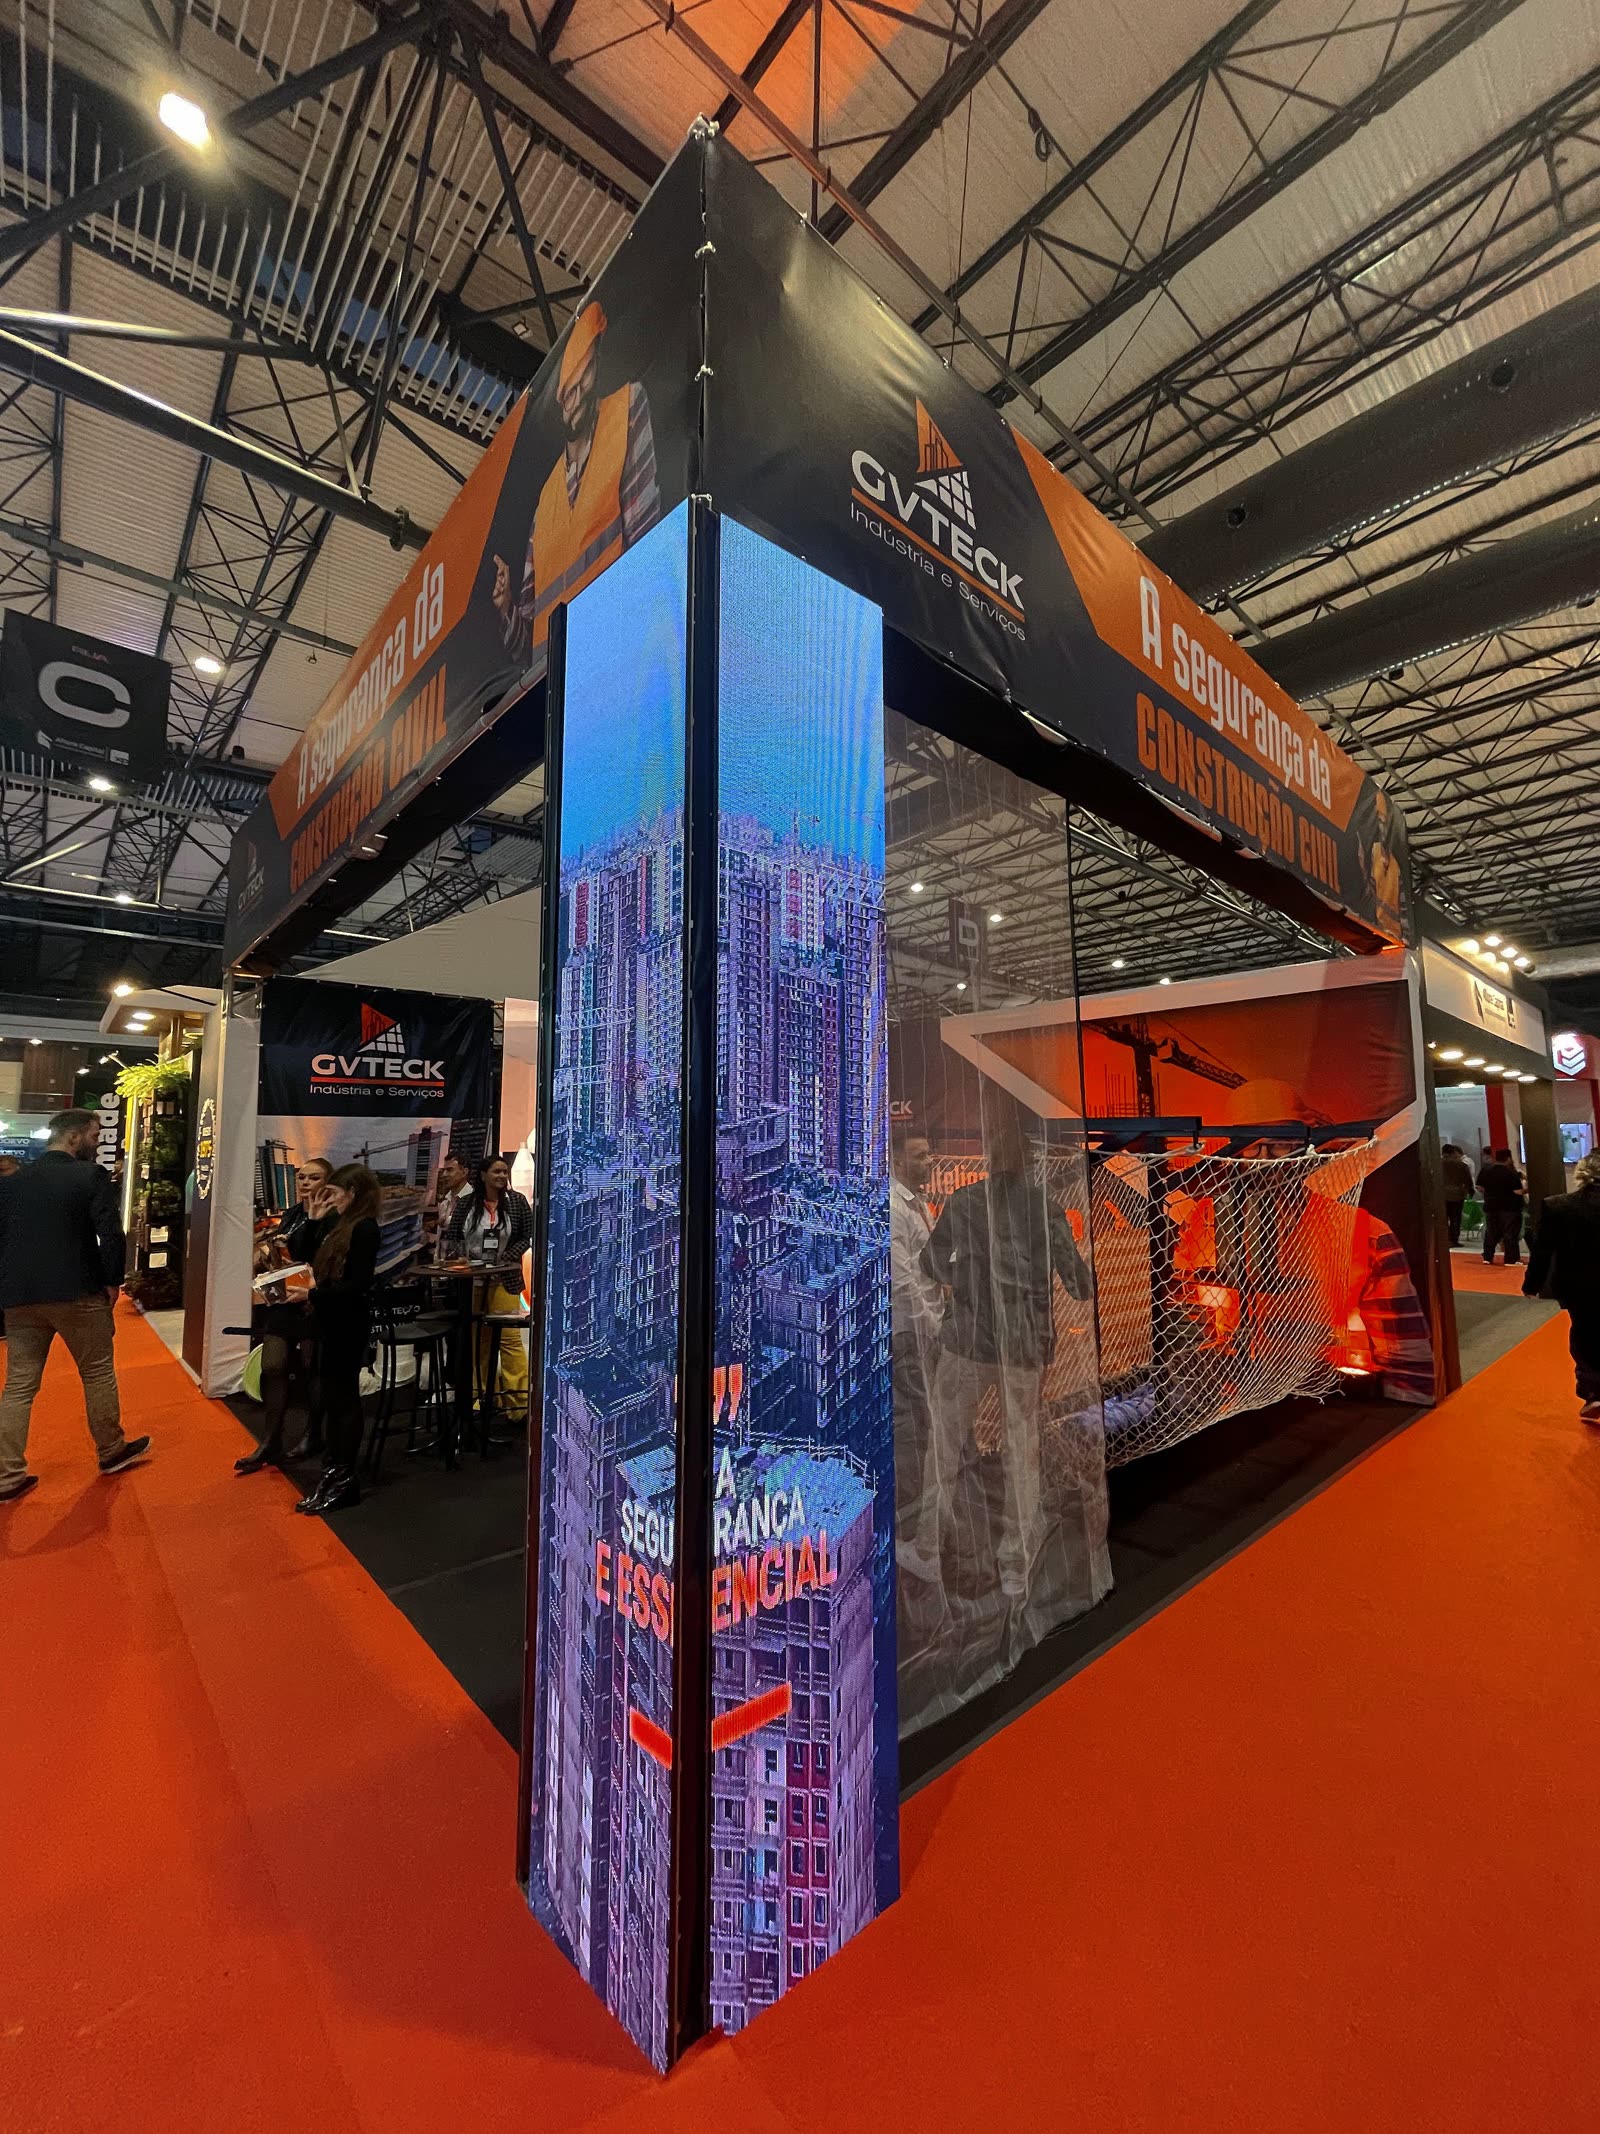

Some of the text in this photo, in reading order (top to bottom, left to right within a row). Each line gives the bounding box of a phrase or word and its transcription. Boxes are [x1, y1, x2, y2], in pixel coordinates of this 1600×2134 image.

[850, 502, 1026, 641] Indústria e Serviços
[851, 450, 1025, 611] GVTECK
[309, 616, 406, 794] segurança
[412, 561, 444, 661] da
[388, 663, 448, 792] CIVIL
[1140, 575, 1332, 811] A segurança da
[1136, 692, 1341, 894] CONSTRUÇÃO CIVIL
[309, 1084, 445, 1099] Indústria e Serviços
[311, 1054, 445, 1080] GVTECK
[95, 1092, 120, 1173] made
[617, 1551, 675, 1647] ESS
[712, 1529, 839, 1634] ENCIAL
[621, 1498, 675, 1566] SEGU
